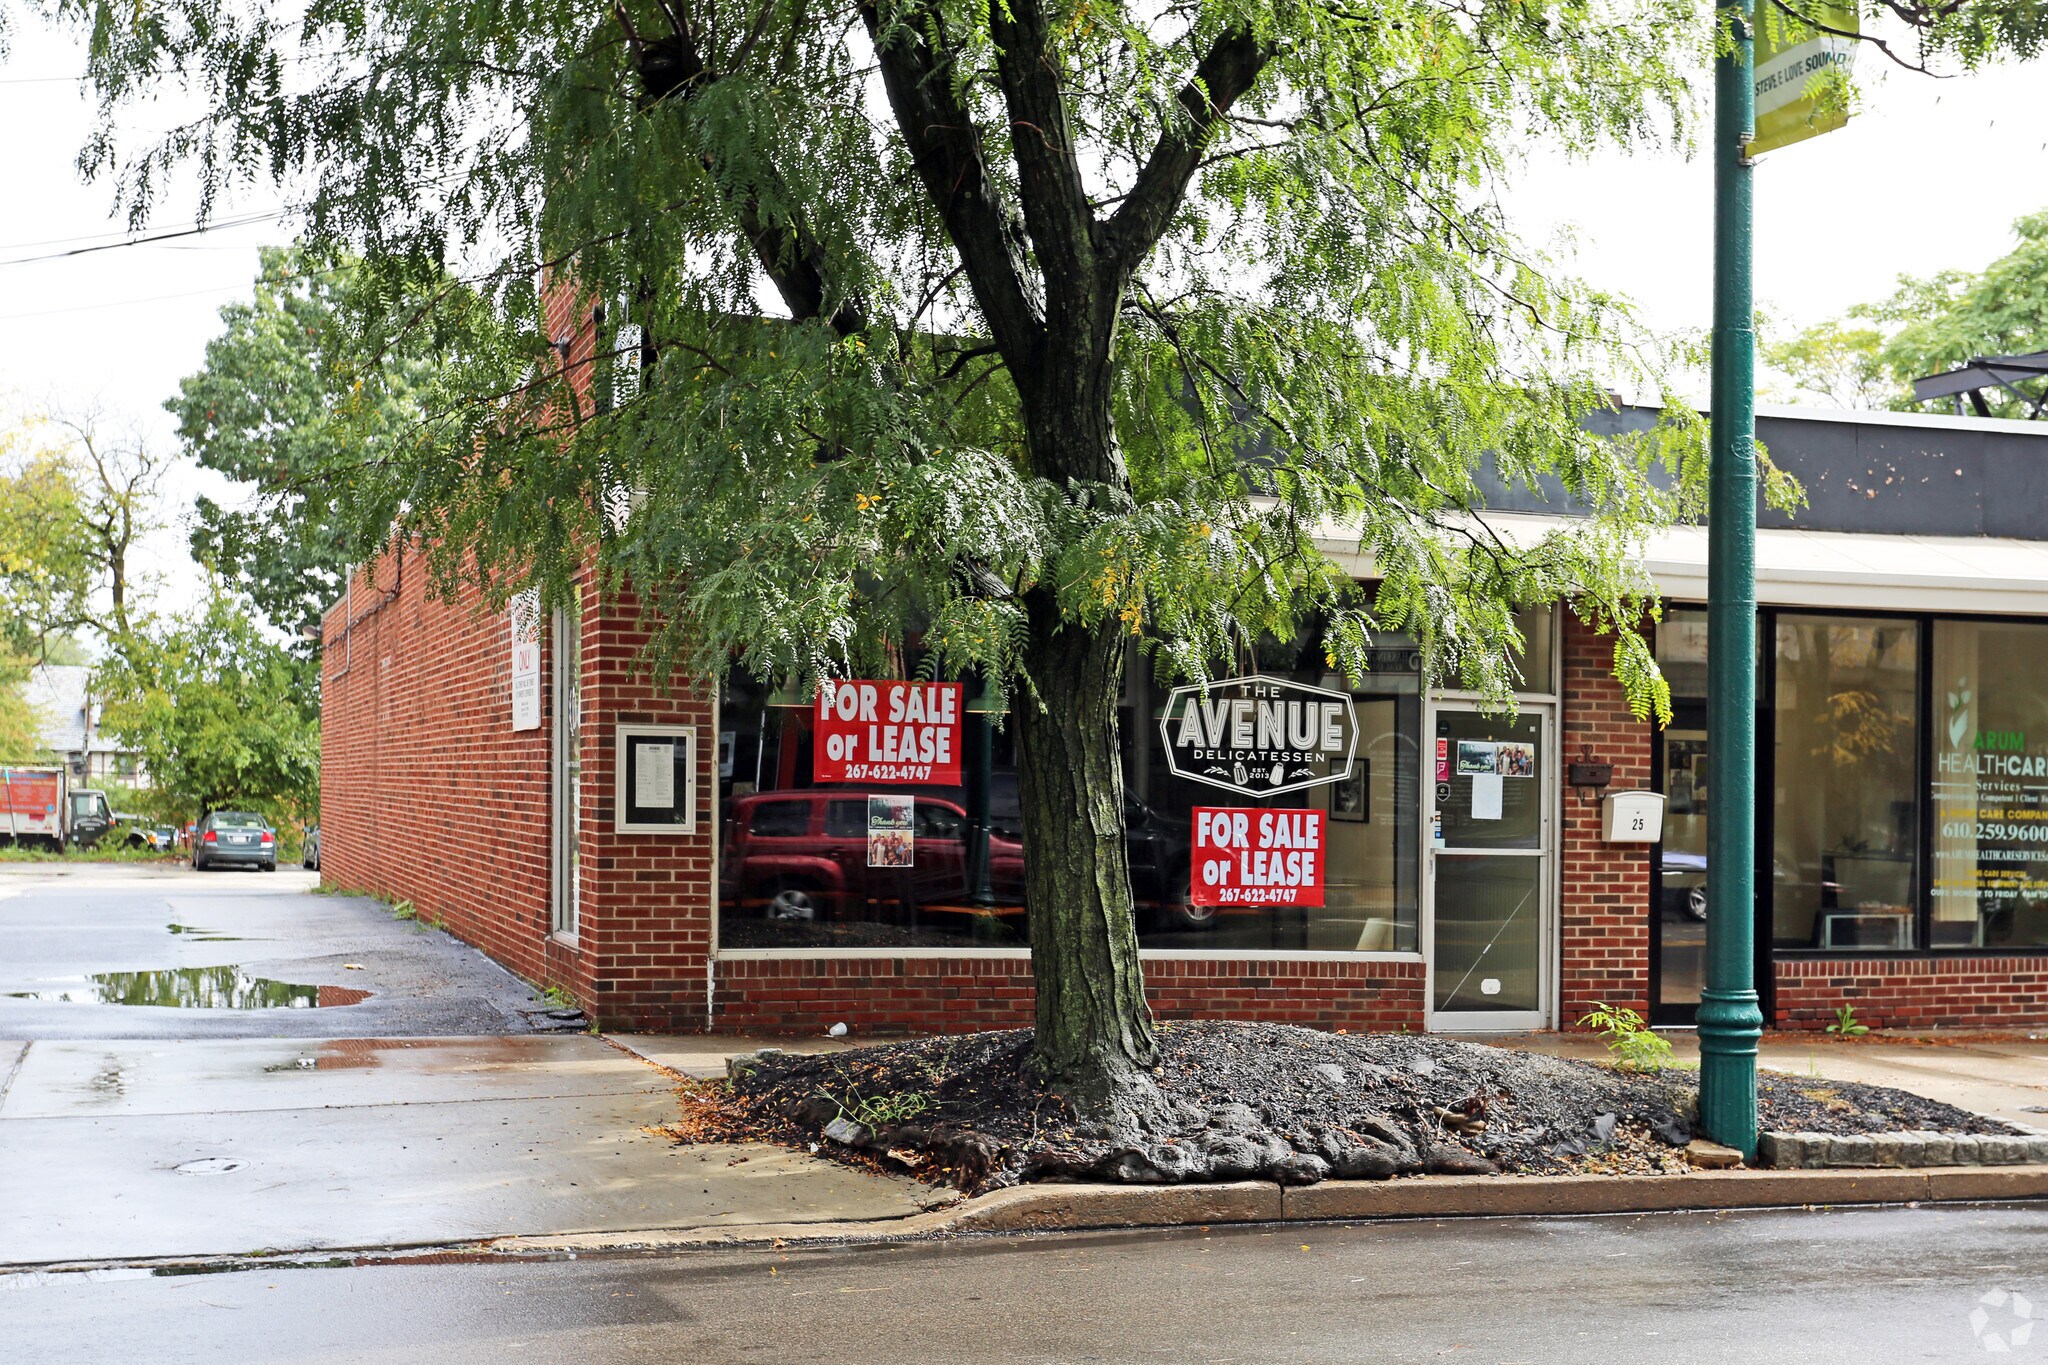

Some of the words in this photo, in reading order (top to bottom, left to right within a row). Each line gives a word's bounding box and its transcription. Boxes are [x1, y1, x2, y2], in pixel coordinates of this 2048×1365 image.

[1755, 73, 1777, 97] STEVE
[1784, 61, 1804, 82] LOVE
[1241, 685, 1280, 698] THE
[821, 683, 878, 722] FOR
[888, 685, 956, 724] SALE
[1176, 698, 1343, 751] AVENUE
[826, 734, 858, 761] or
[868, 725, 951, 763] LEASE
[1972, 731, 2025, 751] ARUM
[1193, 750, 1325, 762] DELICATESSEN
[1938, 752, 2048, 777] HEALTHCAR
[845, 764, 932, 780] 267-622-4747
[1976, 779, 2020, 792] Services
[1979, 809, 2004, 819] CARE
[1197, 812, 1250, 848] FOR
[1258, 813, 1319, 849] SALE
[1632, 818, 1644, 831] 25
[1202, 859, 1231, 886] or
[1241, 851, 1315, 887] LEASE
[1219, 888, 1297, 903] 267-622-4747
[1984, 890, 1994, 898] TO
[1995, 890, 2018, 898] FRIDAY
